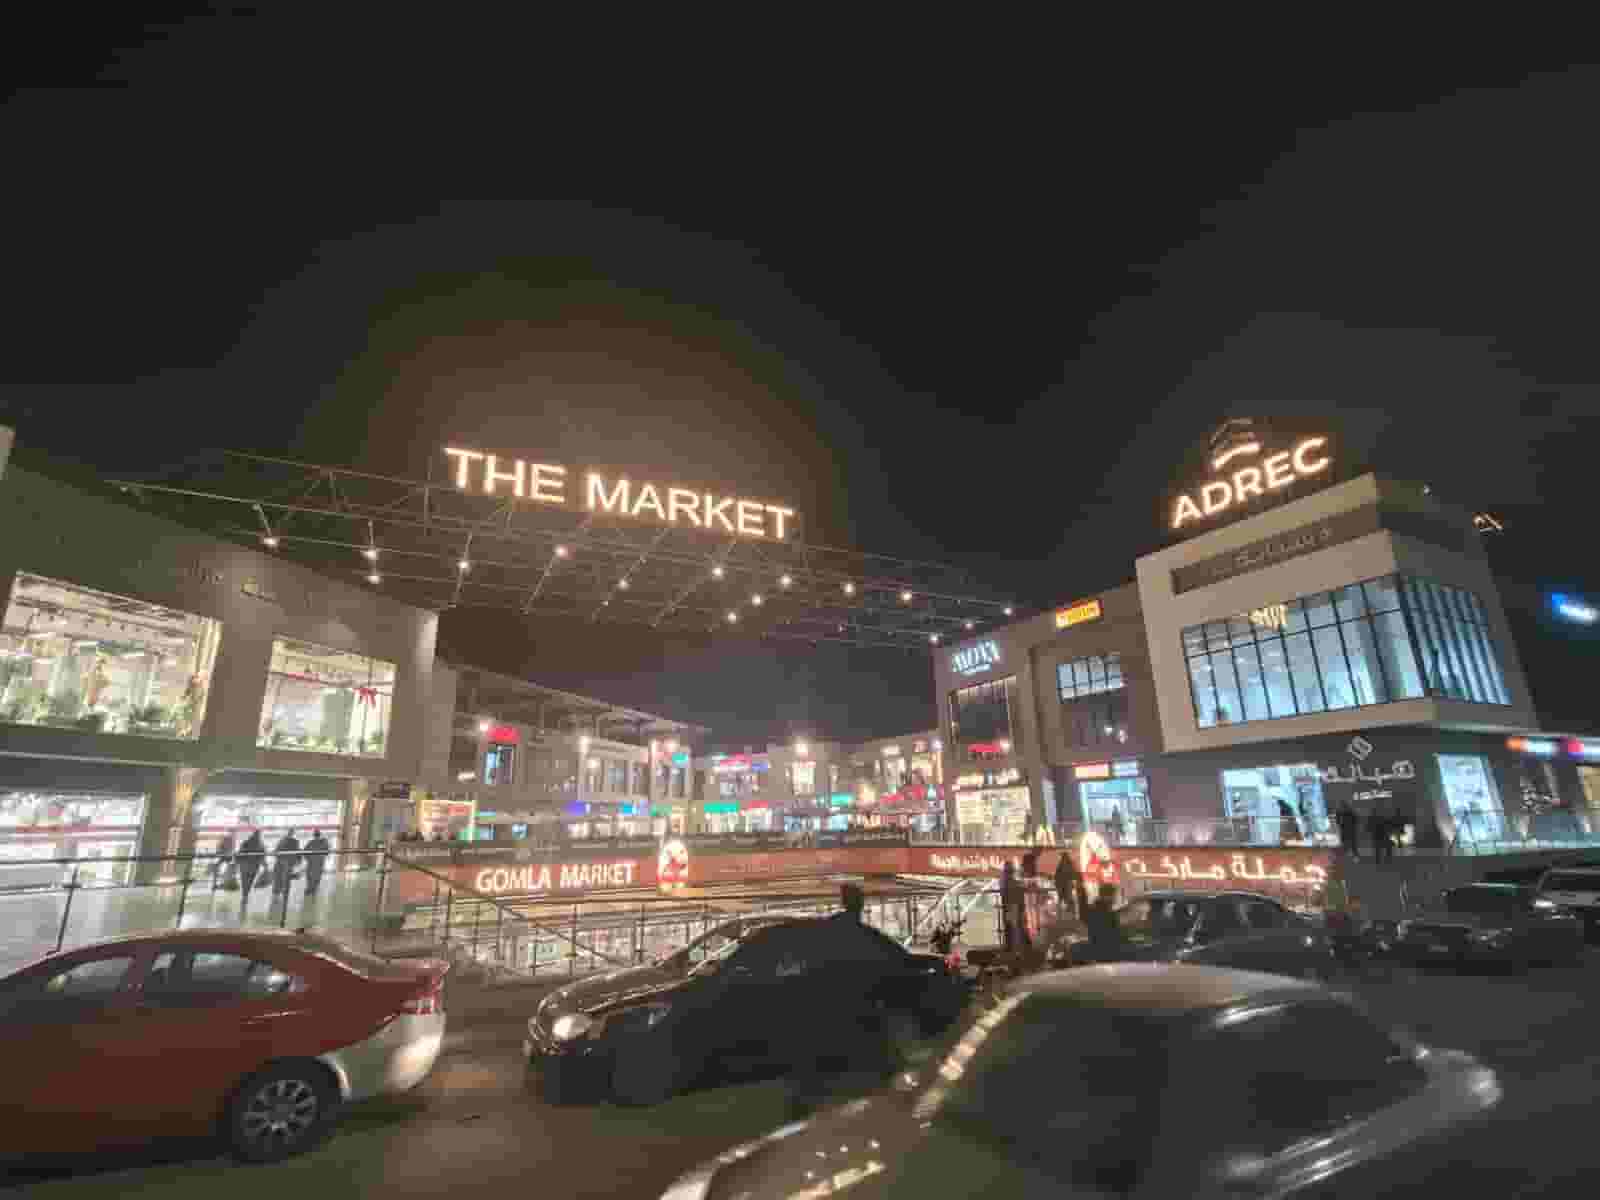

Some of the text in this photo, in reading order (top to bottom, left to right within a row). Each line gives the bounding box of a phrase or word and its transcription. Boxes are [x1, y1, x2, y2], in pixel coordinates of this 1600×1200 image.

[443, 446, 794, 540] THE MARKET
[1169, 435, 1331, 529] ADREC
[475, 862, 634, 893] GOMLA MARKET
